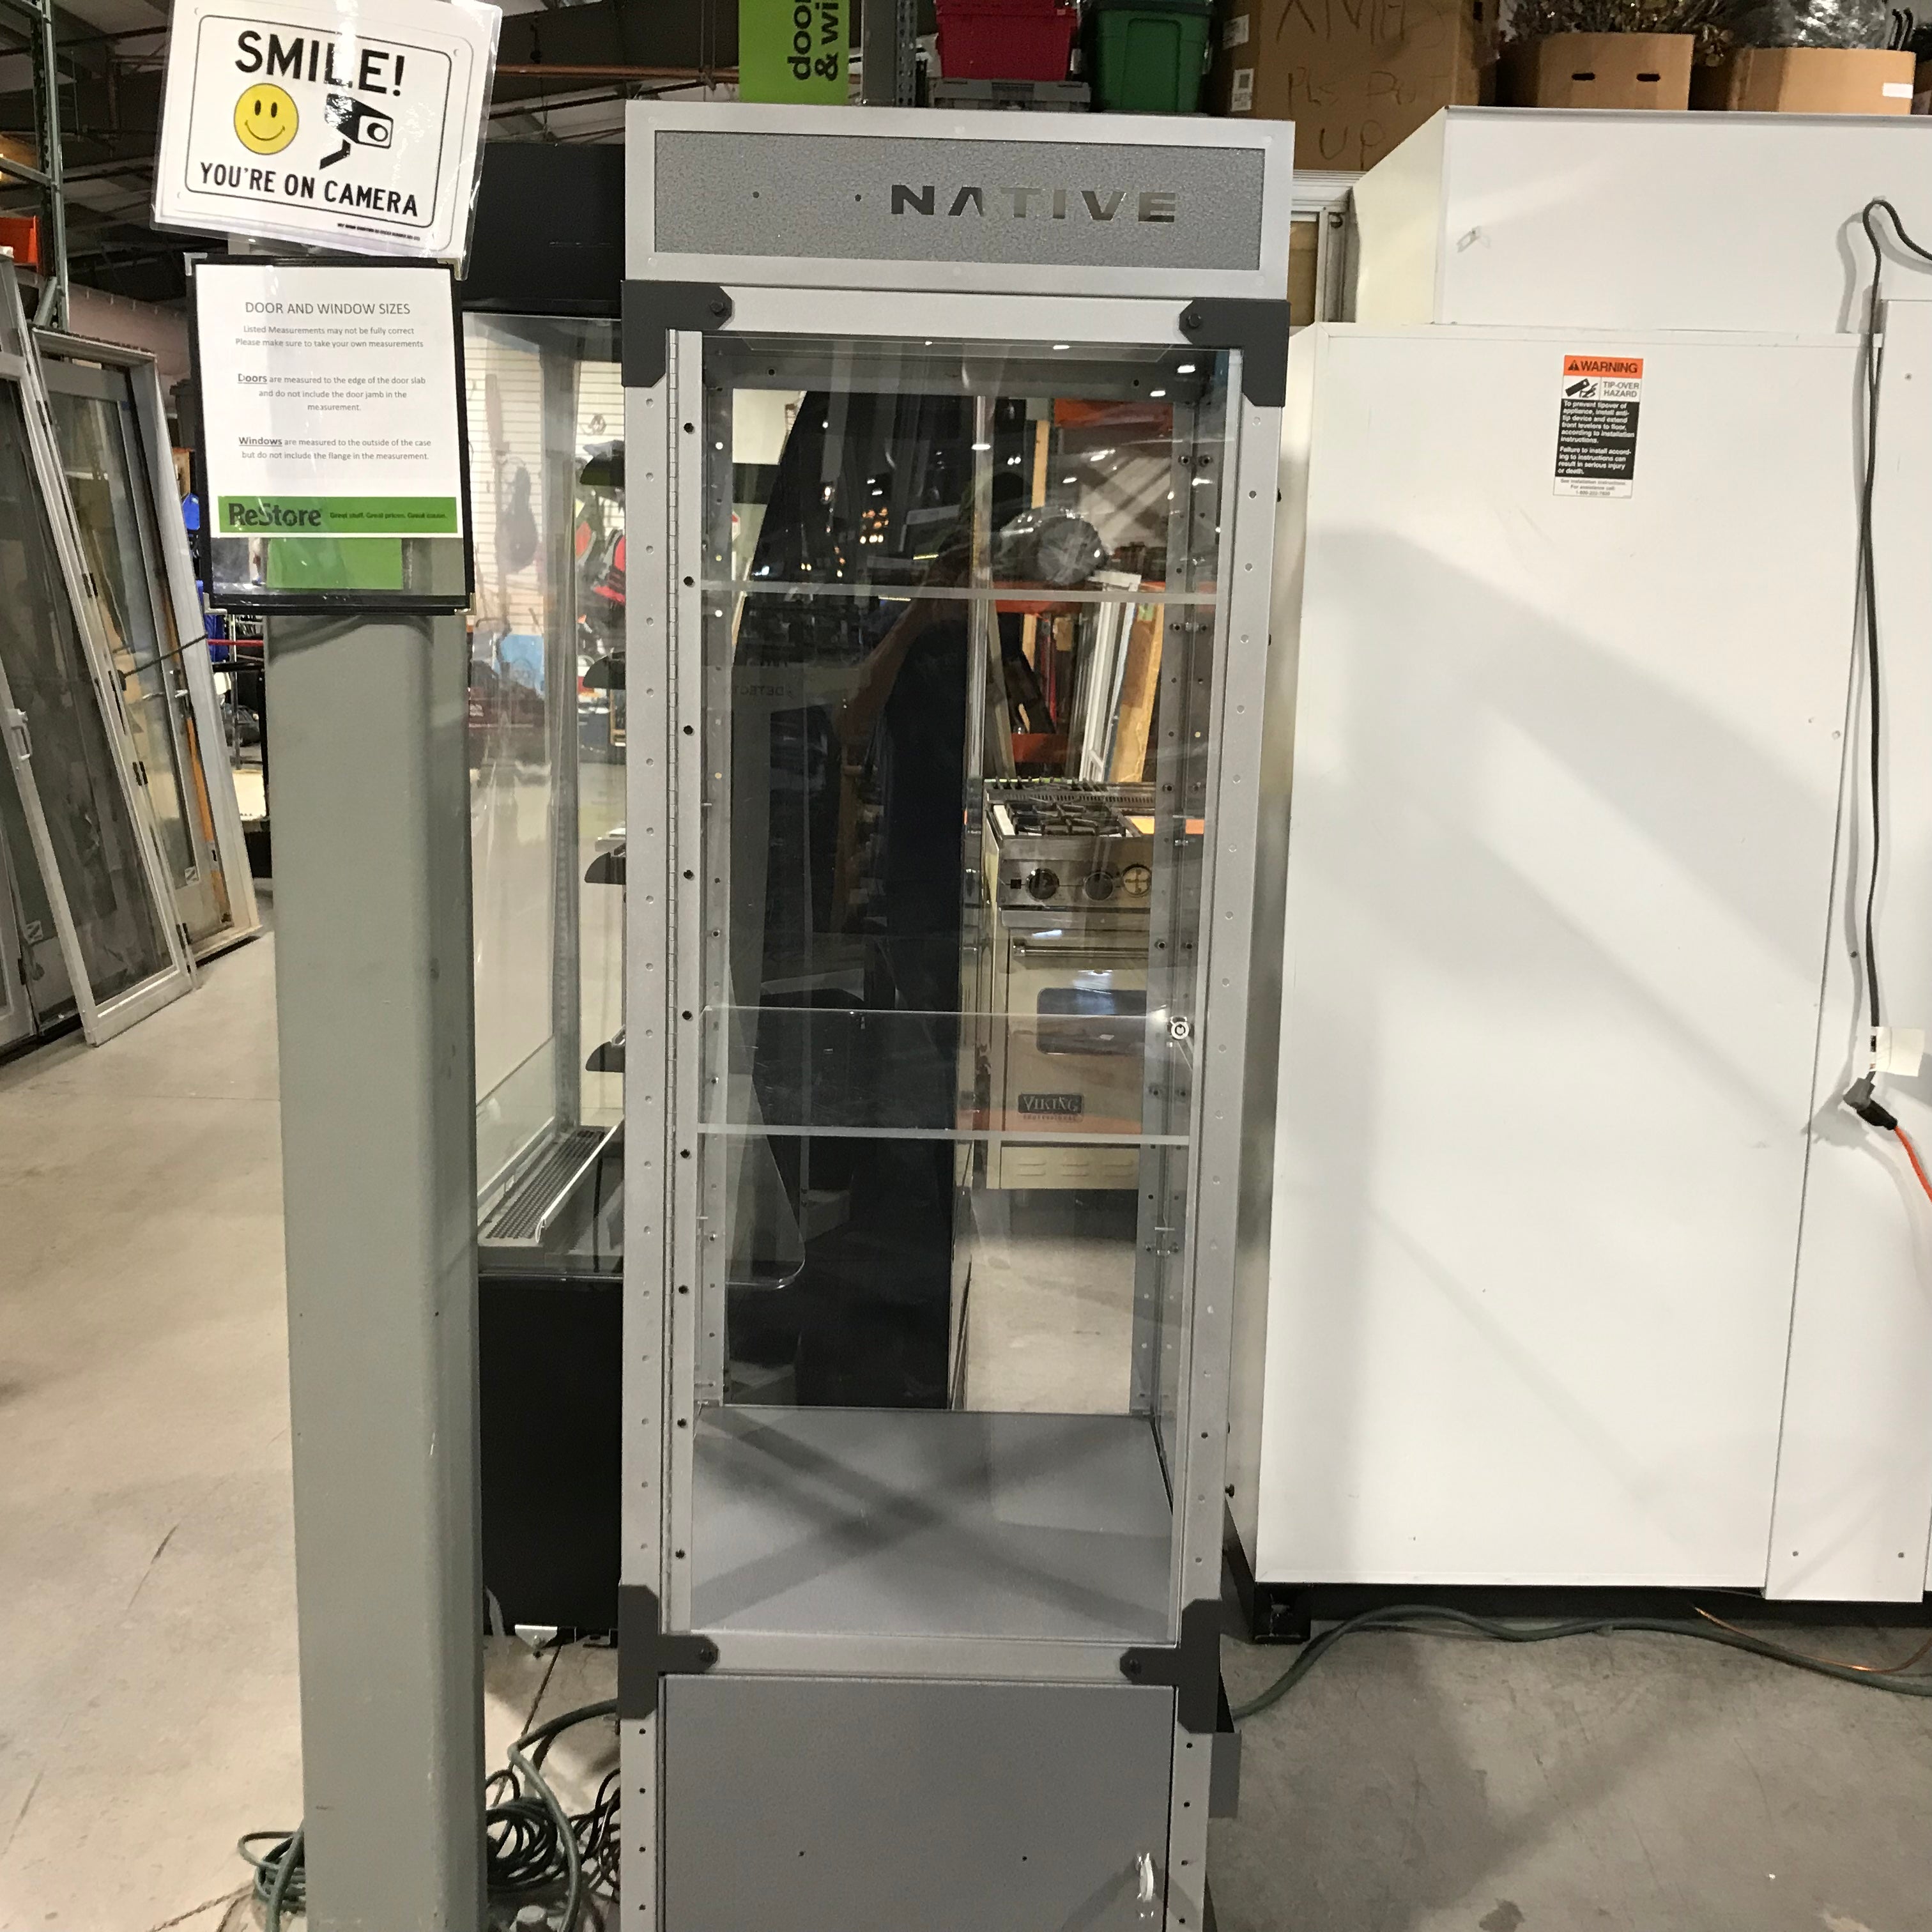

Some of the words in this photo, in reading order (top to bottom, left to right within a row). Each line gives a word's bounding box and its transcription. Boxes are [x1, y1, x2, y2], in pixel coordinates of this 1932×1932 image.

[235, 30, 405, 96] SMILE!
[815, 52, 838, 81] &
[1319, 119, 1386, 171] UP
[200, 162, 276, 193] YOU'RE
[284, 174, 315, 199] ON
[325, 180, 418, 217] CAMERA
[891, 185, 1176, 222] NATIVE
[245, 302, 283, 313] DOOR
[288, 303, 314, 314] AND
[317, 303, 375, 314] WINDOW
[379, 303, 410, 314] SIZES
[371, 327, 386, 335] fully
[1581, 361, 1637, 373] WARNING
[238, 373, 268, 383] Doors
[348, 377, 366, 385] edge
[1603, 381, 1639, 389] TIP-OVER
[365, 390, 384, 399] jamb
[238, 437, 282, 445] Windows
[328, 452, 351, 461] flange
[229, 503, 321, 526] ReStore
[1023, 1096, 1079, 1111] VIKING
